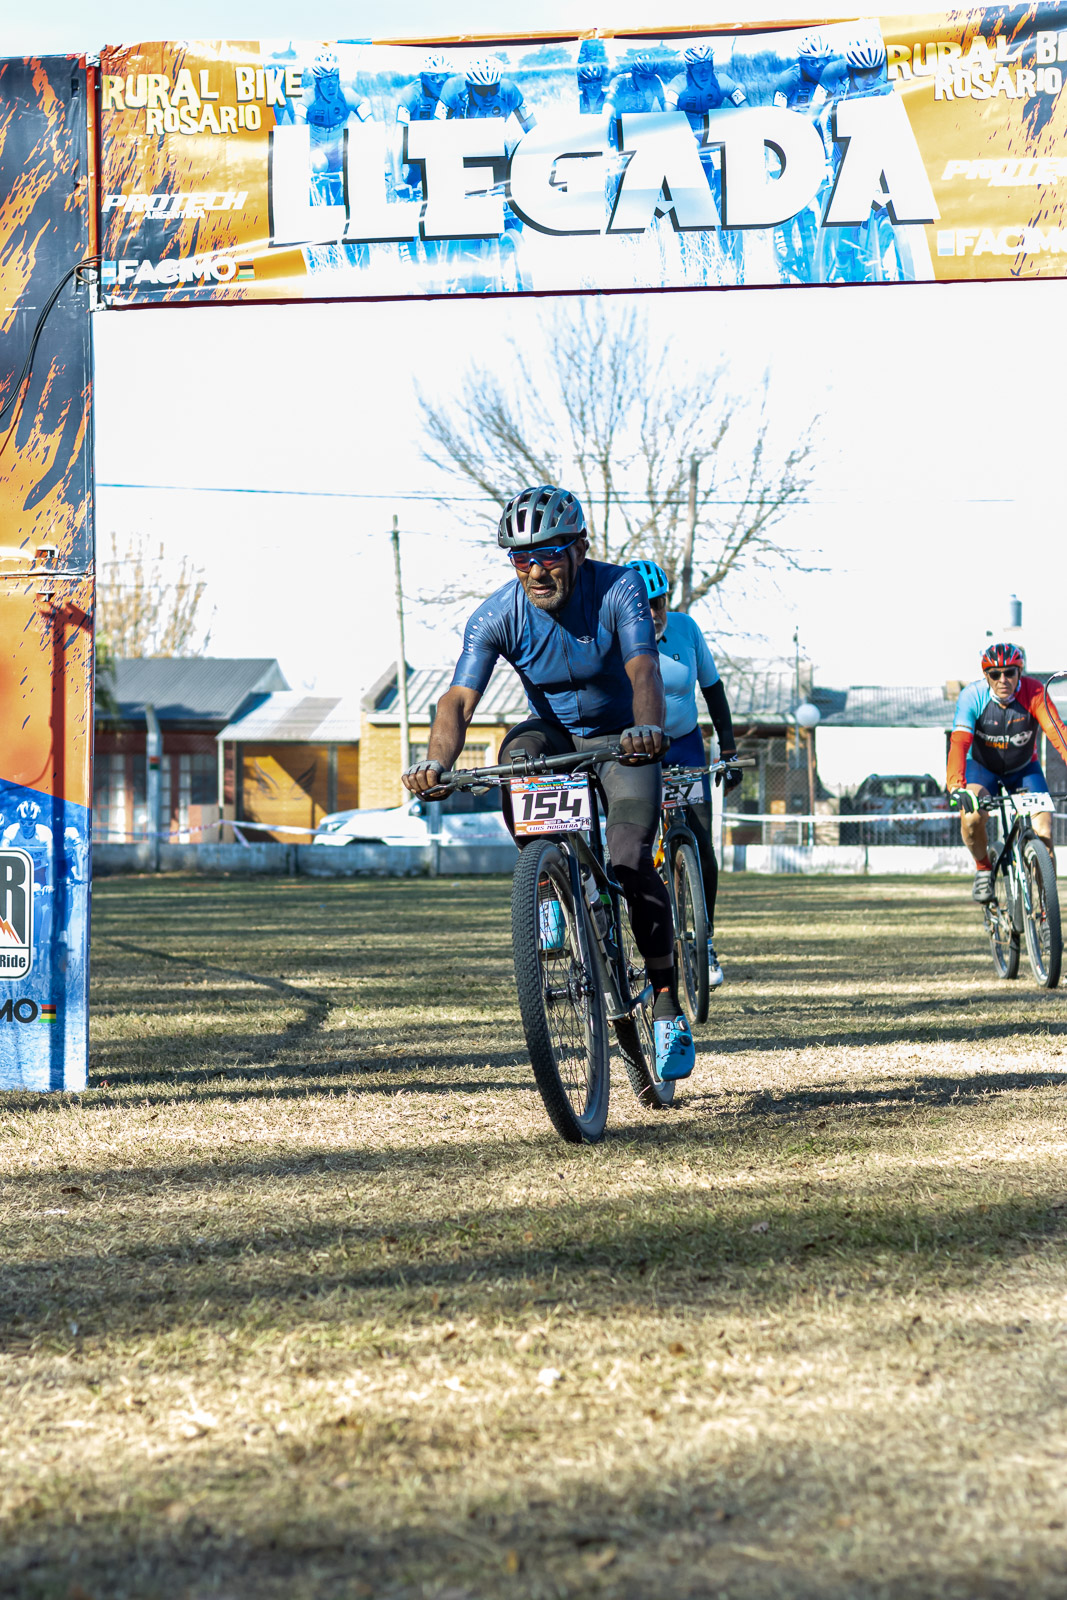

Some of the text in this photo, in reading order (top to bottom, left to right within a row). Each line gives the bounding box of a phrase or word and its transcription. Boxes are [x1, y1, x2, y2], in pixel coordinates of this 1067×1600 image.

[886, 35, 1022, 80] RURAL
[101, 66, 303, 111] RURAL BIKE
[934, 67, 1062, 101] ROSARIO
[146, 104, 262, 135] ROSARIO
[268, 95, 940, 248] LLEGADA
[101, 191, 249, 213] PROTECH
[117, 257, 237, 284] FACIMO
[522, 791, 582, 820] 154
